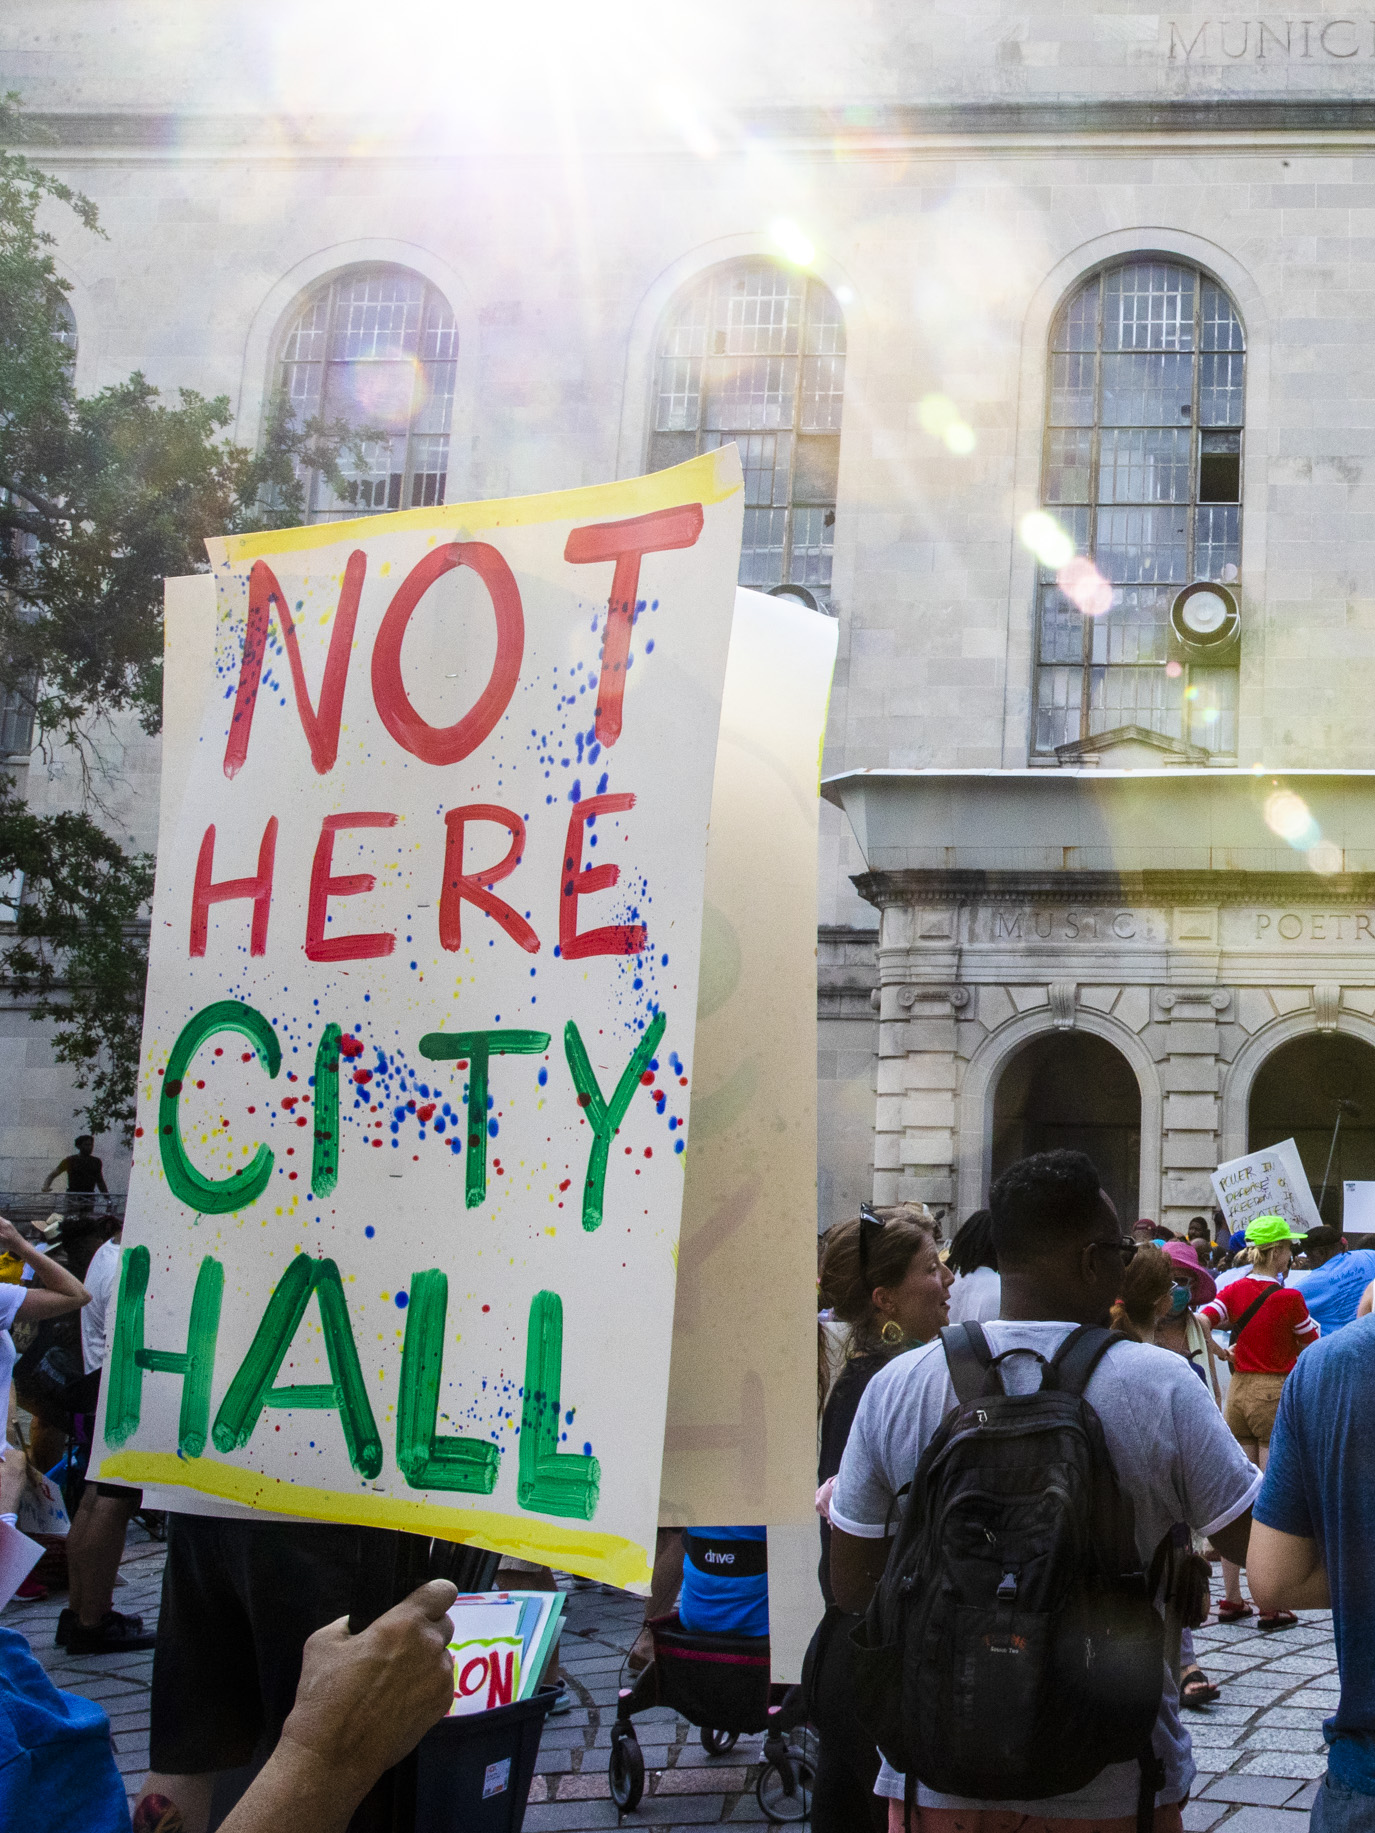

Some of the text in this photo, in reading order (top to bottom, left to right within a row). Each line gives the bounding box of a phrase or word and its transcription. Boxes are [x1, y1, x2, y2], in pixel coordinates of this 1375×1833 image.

[223, 502, 705, 781] NOT
[188, 792, 649, 962] HERE
[996, 912, 1136, 940] MUSIC
[158, 999, 667, 1233] CITY
[104, 1244, 601, 1521] HALL
[704, 1548, 735, 1564] drive
[453, 1650, 514, 1710] ON
